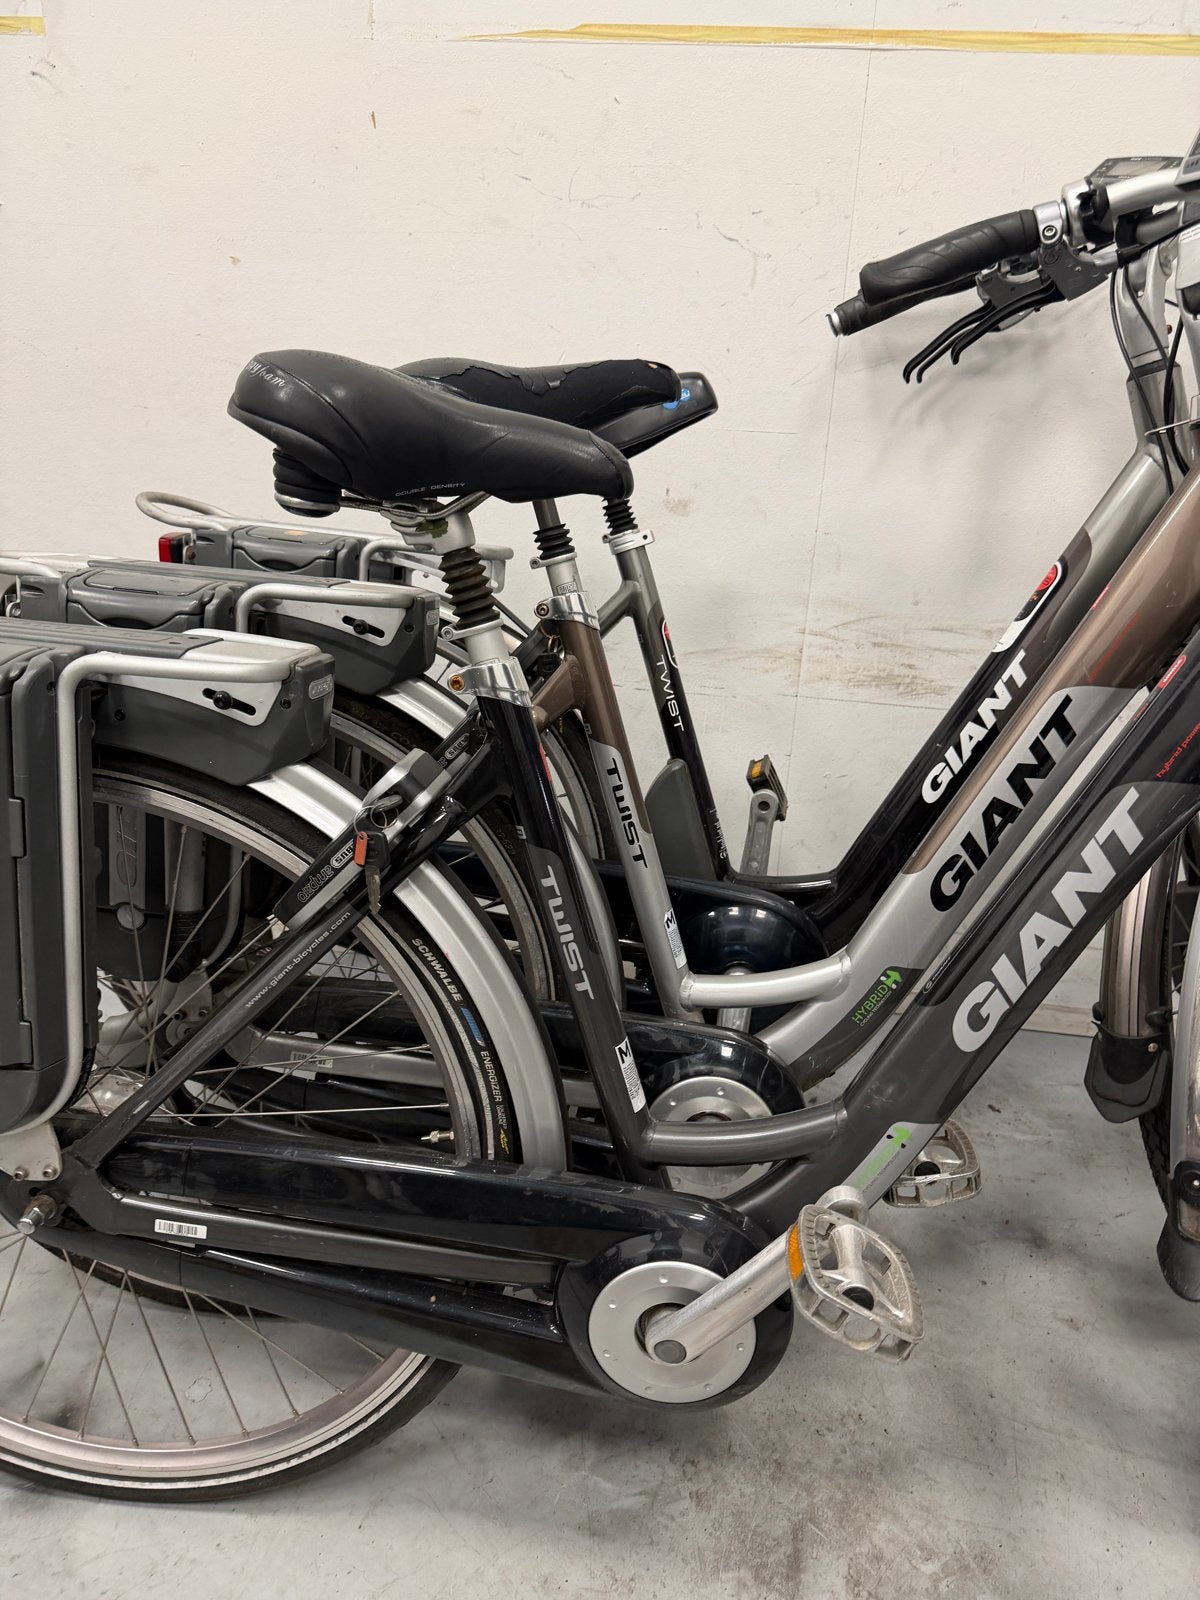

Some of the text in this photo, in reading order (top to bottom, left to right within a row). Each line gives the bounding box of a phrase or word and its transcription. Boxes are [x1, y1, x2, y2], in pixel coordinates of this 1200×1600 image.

[656, 654, 684, 732] TWIST
[921, 649, 1028, 804] GIANT
[1156, 747, 1183, 778] hybrid
[606, 757, 648, 869] TWIST
[930, 694, 1077, 912] GIANT
[297, 864, 335, 903] amparo
[952, 785, 1144, 1052] GIANT
[245, 911, 352, 1008] www.giant-bicycles.com
[412, 938, 463, 1002] SCHWALBE
[540, 865, 595, 1000] TWIST
[851, 984, 889, 1024] HYBRID
[481, 1050, 503, 1102] ENERGIZER
[617, 1040, 632, 1065] M
